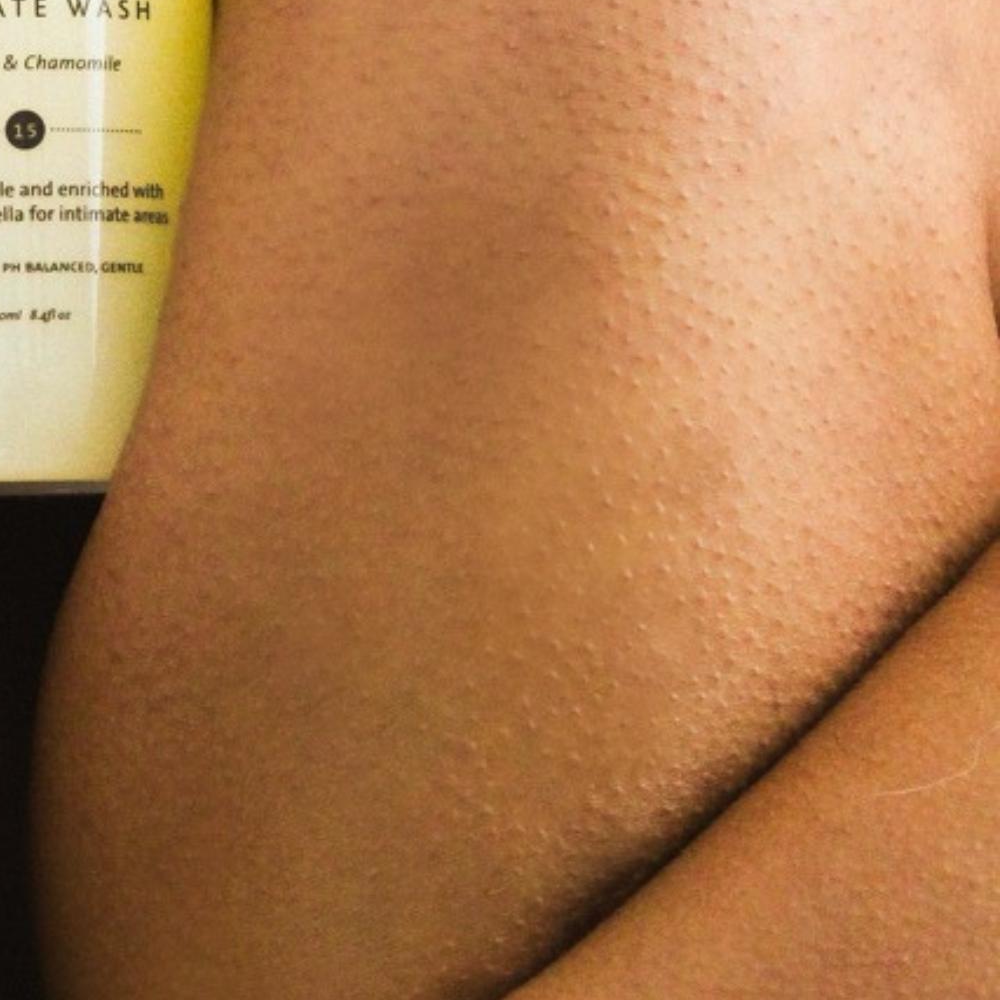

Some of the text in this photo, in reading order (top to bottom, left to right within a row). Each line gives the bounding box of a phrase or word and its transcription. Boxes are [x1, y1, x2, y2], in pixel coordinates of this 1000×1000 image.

[67, 0, 151, 21] WASH
[3, 54, 18, 71] &
[24, 55, 122, 72] Chamomile
[14, 123, 38, 139] 15
[19, 182, 53, 198] and
[58, 182, 129, 199] enriched
[133, 183, 164, 200] with
[29, 205, 54, 222] for
[59, 206, 130, 223] intimate
[134, 210, 169, 225] areas
[3, 264, 21, 274] PH
[25, 262, 98, 275] BALANCED,
[101, 262, 144, 274] GENTLE
